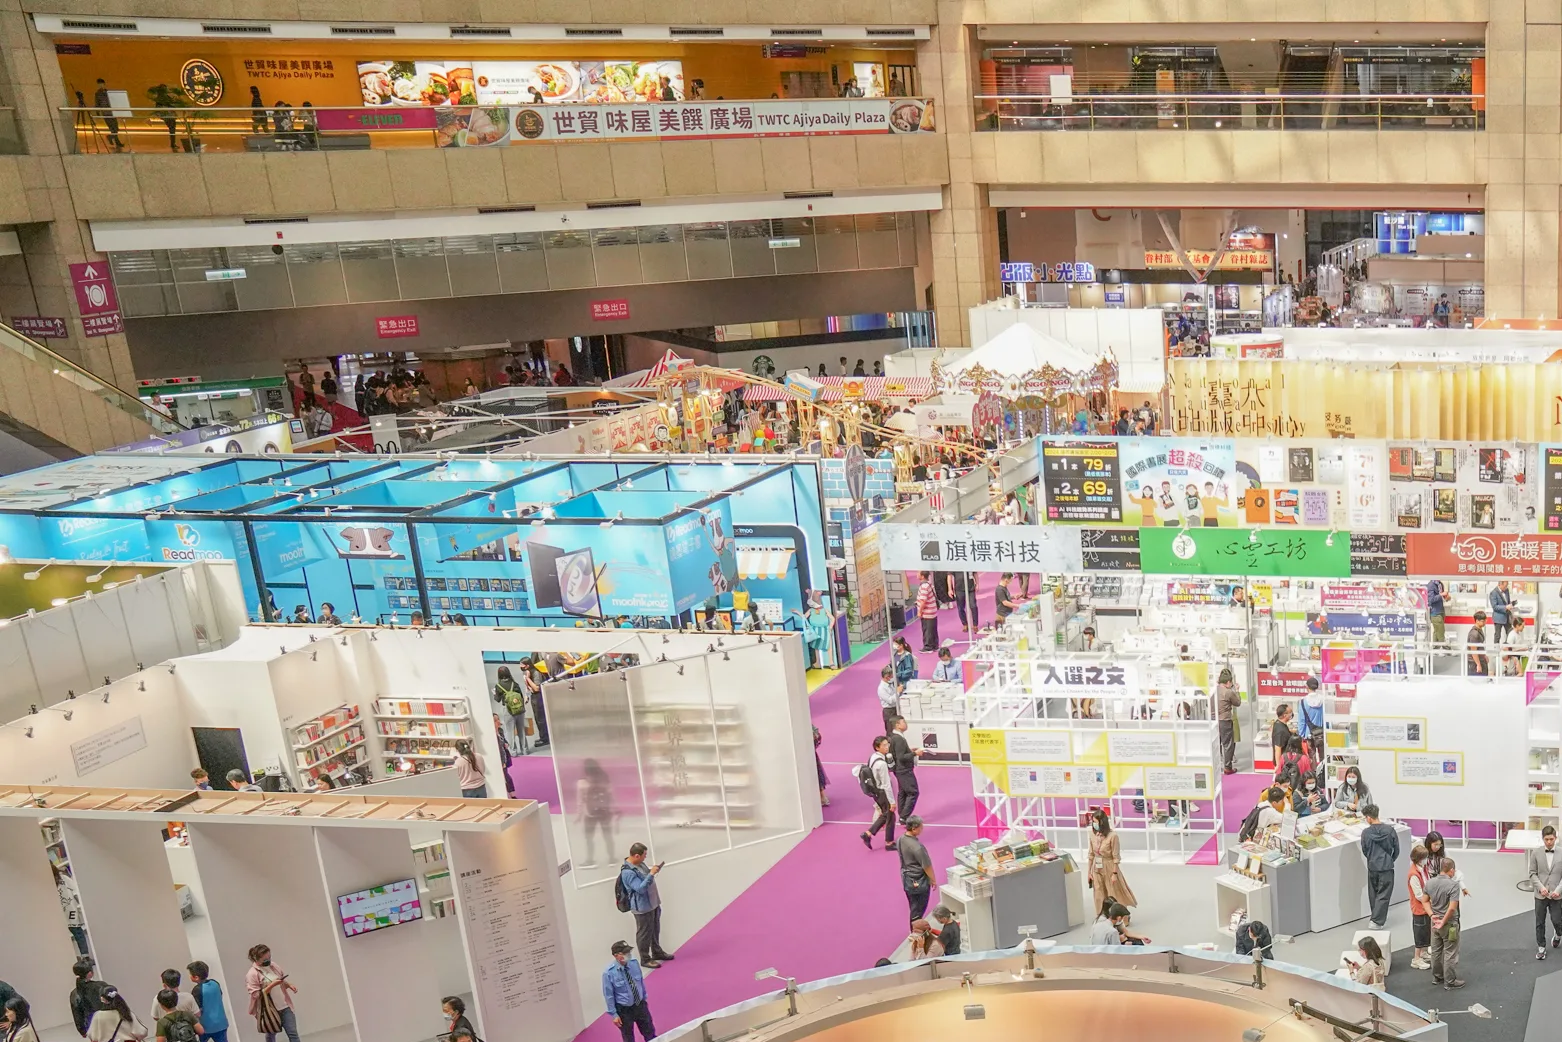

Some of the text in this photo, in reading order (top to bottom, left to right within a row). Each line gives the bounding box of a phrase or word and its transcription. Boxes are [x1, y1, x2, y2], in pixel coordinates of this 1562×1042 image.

[552, 106, 886, 136] 世貿味屋美饌廣場 TWTC Ajiya Daily Plaza
[593, 303, 628, 312] 緊急出口
[379, 318, 417, 329] 緊急出口
[162, 547, 223, 560] Readmoo
[945, 539, 1041, 564] 旗標科技
[1044, 665, 1126, 686] 人選之文
